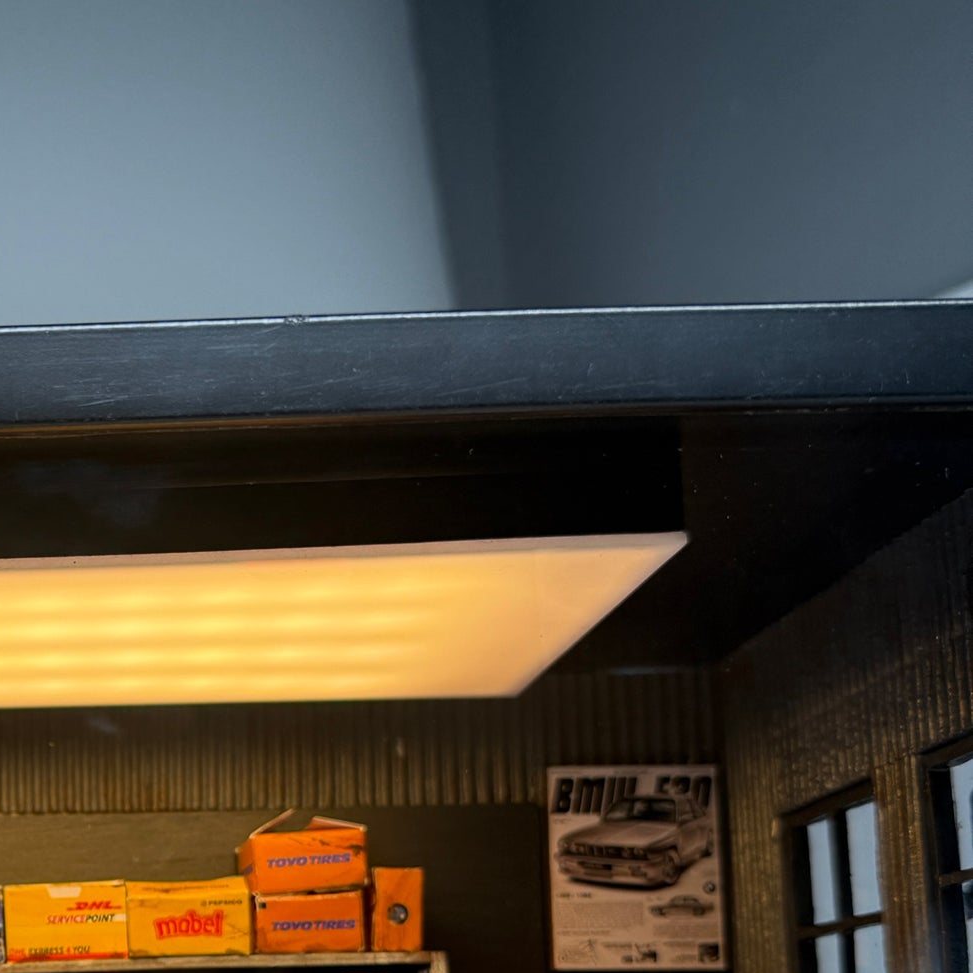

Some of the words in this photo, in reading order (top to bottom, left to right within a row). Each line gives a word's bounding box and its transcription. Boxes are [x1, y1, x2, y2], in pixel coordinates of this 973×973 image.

[268, 856, 308, 868] TOYO
[311, 853, 352, 865] TIRES
[71, 901, 114, 911] DHL
[273, 921, 314, 931] TOYO
[315, 920, 356, 930] TIRES
[28, 947, 64, 956] EXPRESS
[73, 946, 90, 954] YOU
